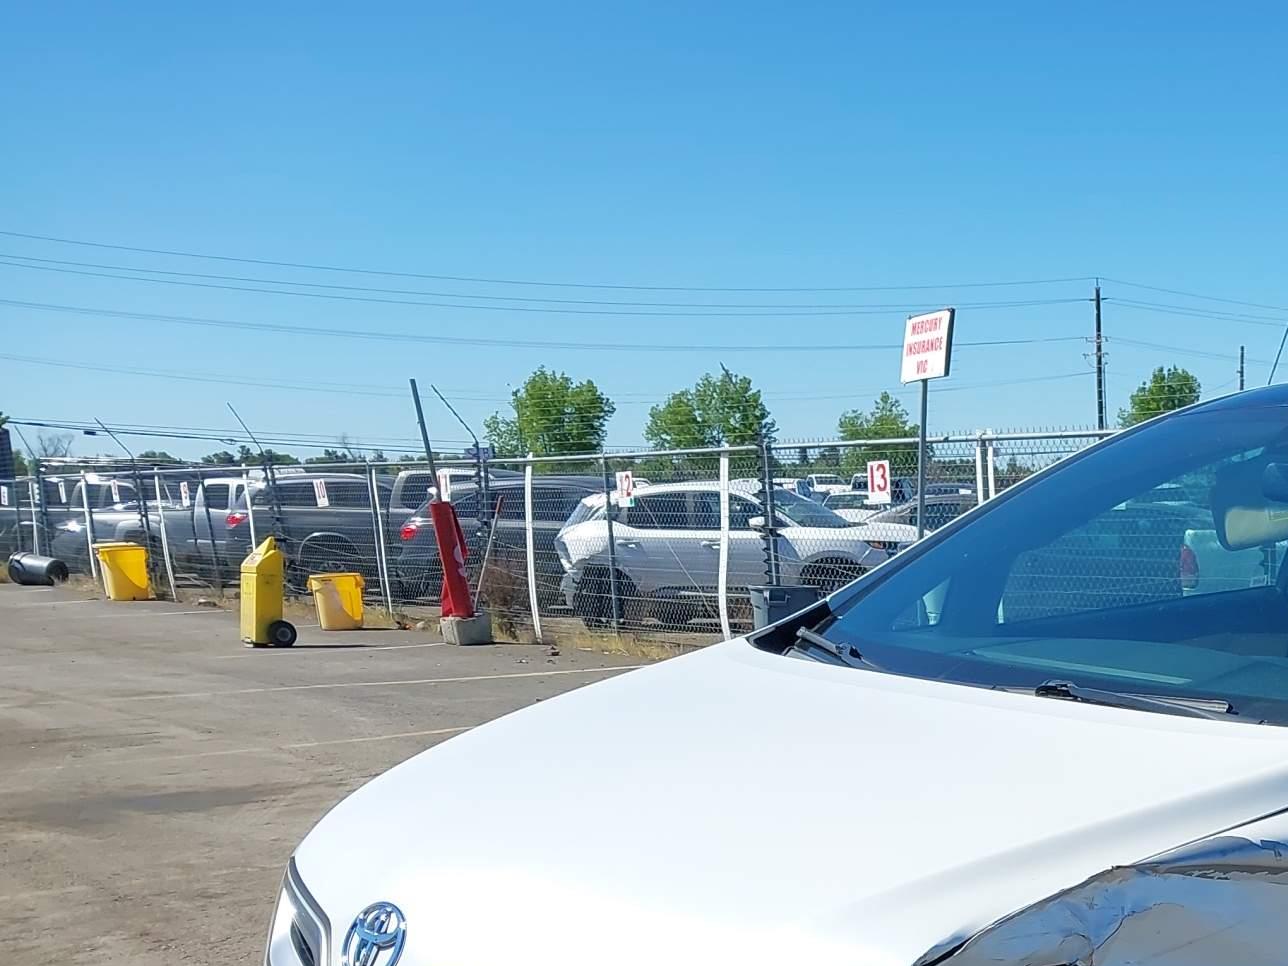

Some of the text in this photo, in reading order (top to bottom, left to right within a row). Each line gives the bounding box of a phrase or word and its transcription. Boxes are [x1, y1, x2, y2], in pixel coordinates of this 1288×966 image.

[911, 316, 943, 336] MERCURY
[906, 336, 944, 357] INSURANCE
[619, 473, 632, 497] 12
[870, 463, 888, 492] 13
[315, 480, 326, 499] 10
